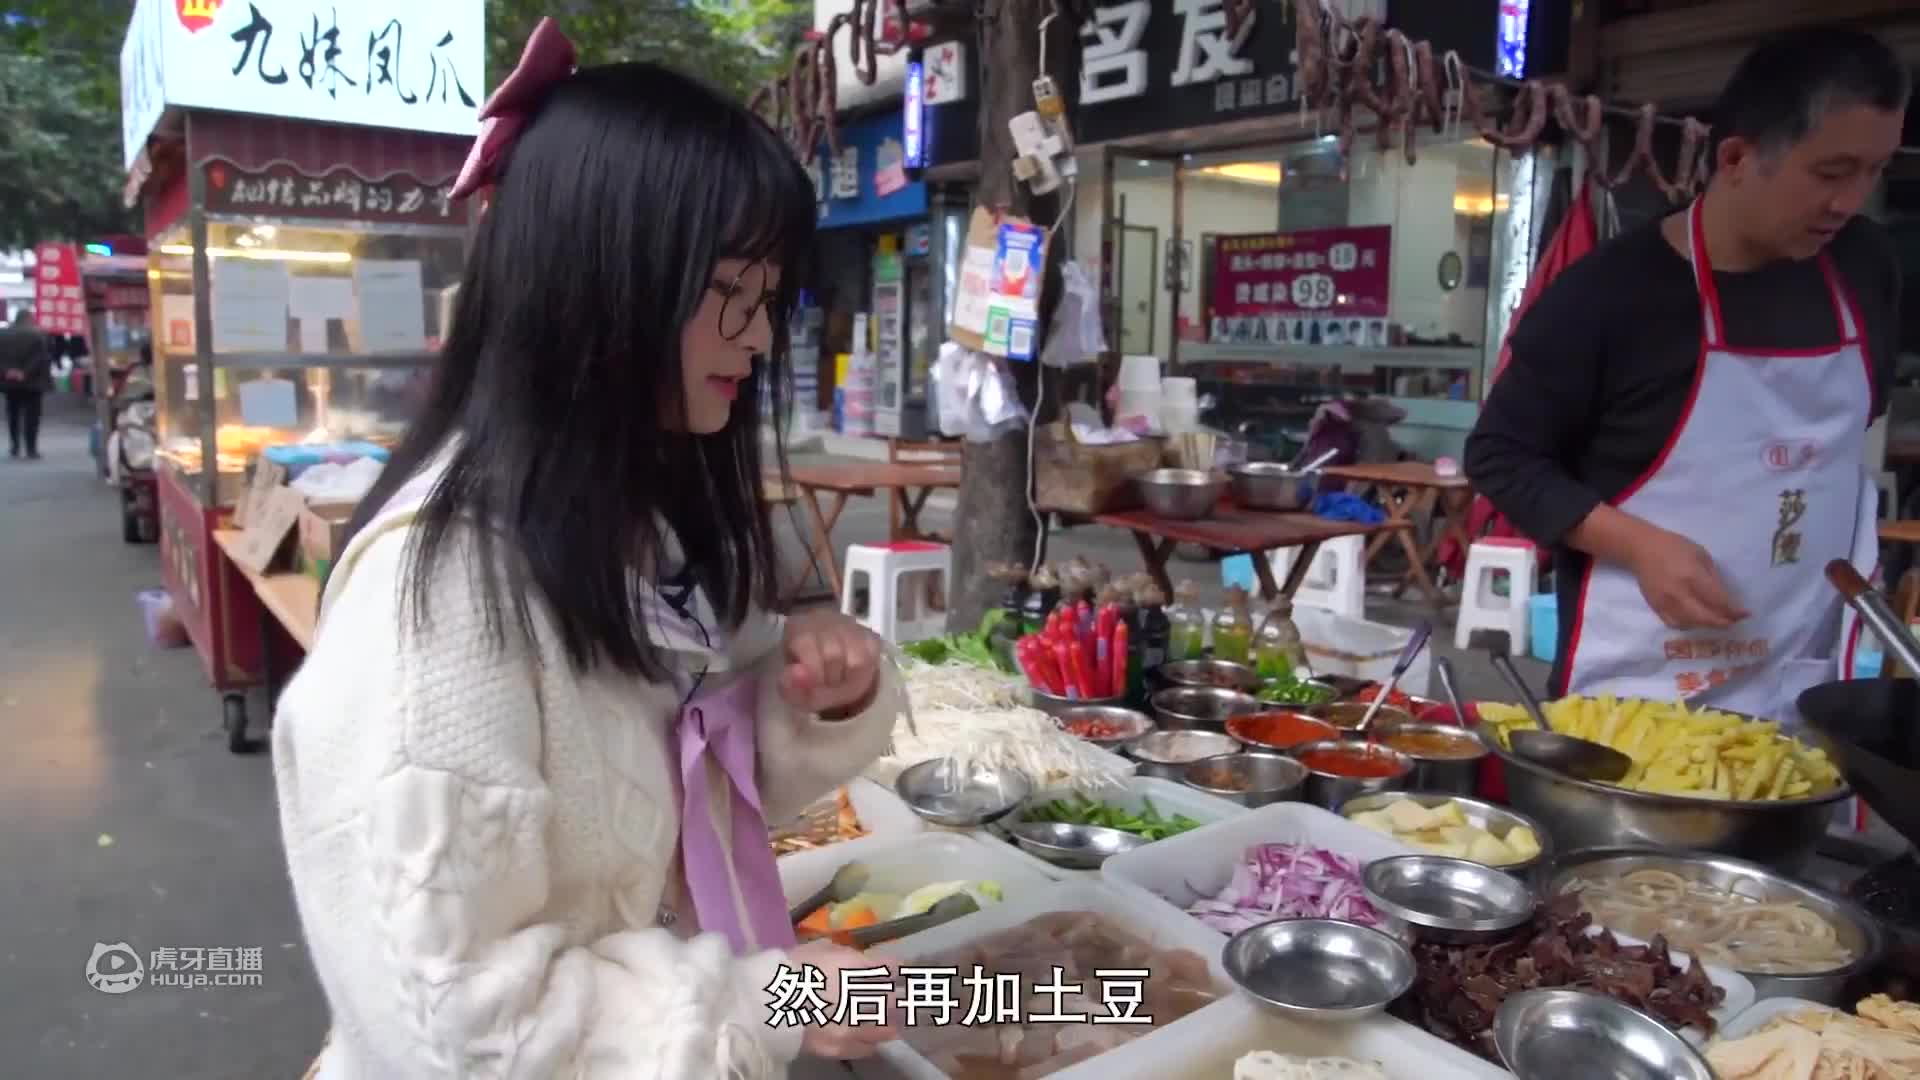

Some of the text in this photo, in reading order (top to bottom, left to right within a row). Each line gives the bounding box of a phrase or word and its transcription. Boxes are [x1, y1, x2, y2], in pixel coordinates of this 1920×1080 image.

[230, 3, 477, 109] 九妹凤爪
[1299, 280, 1329, 303] 98
